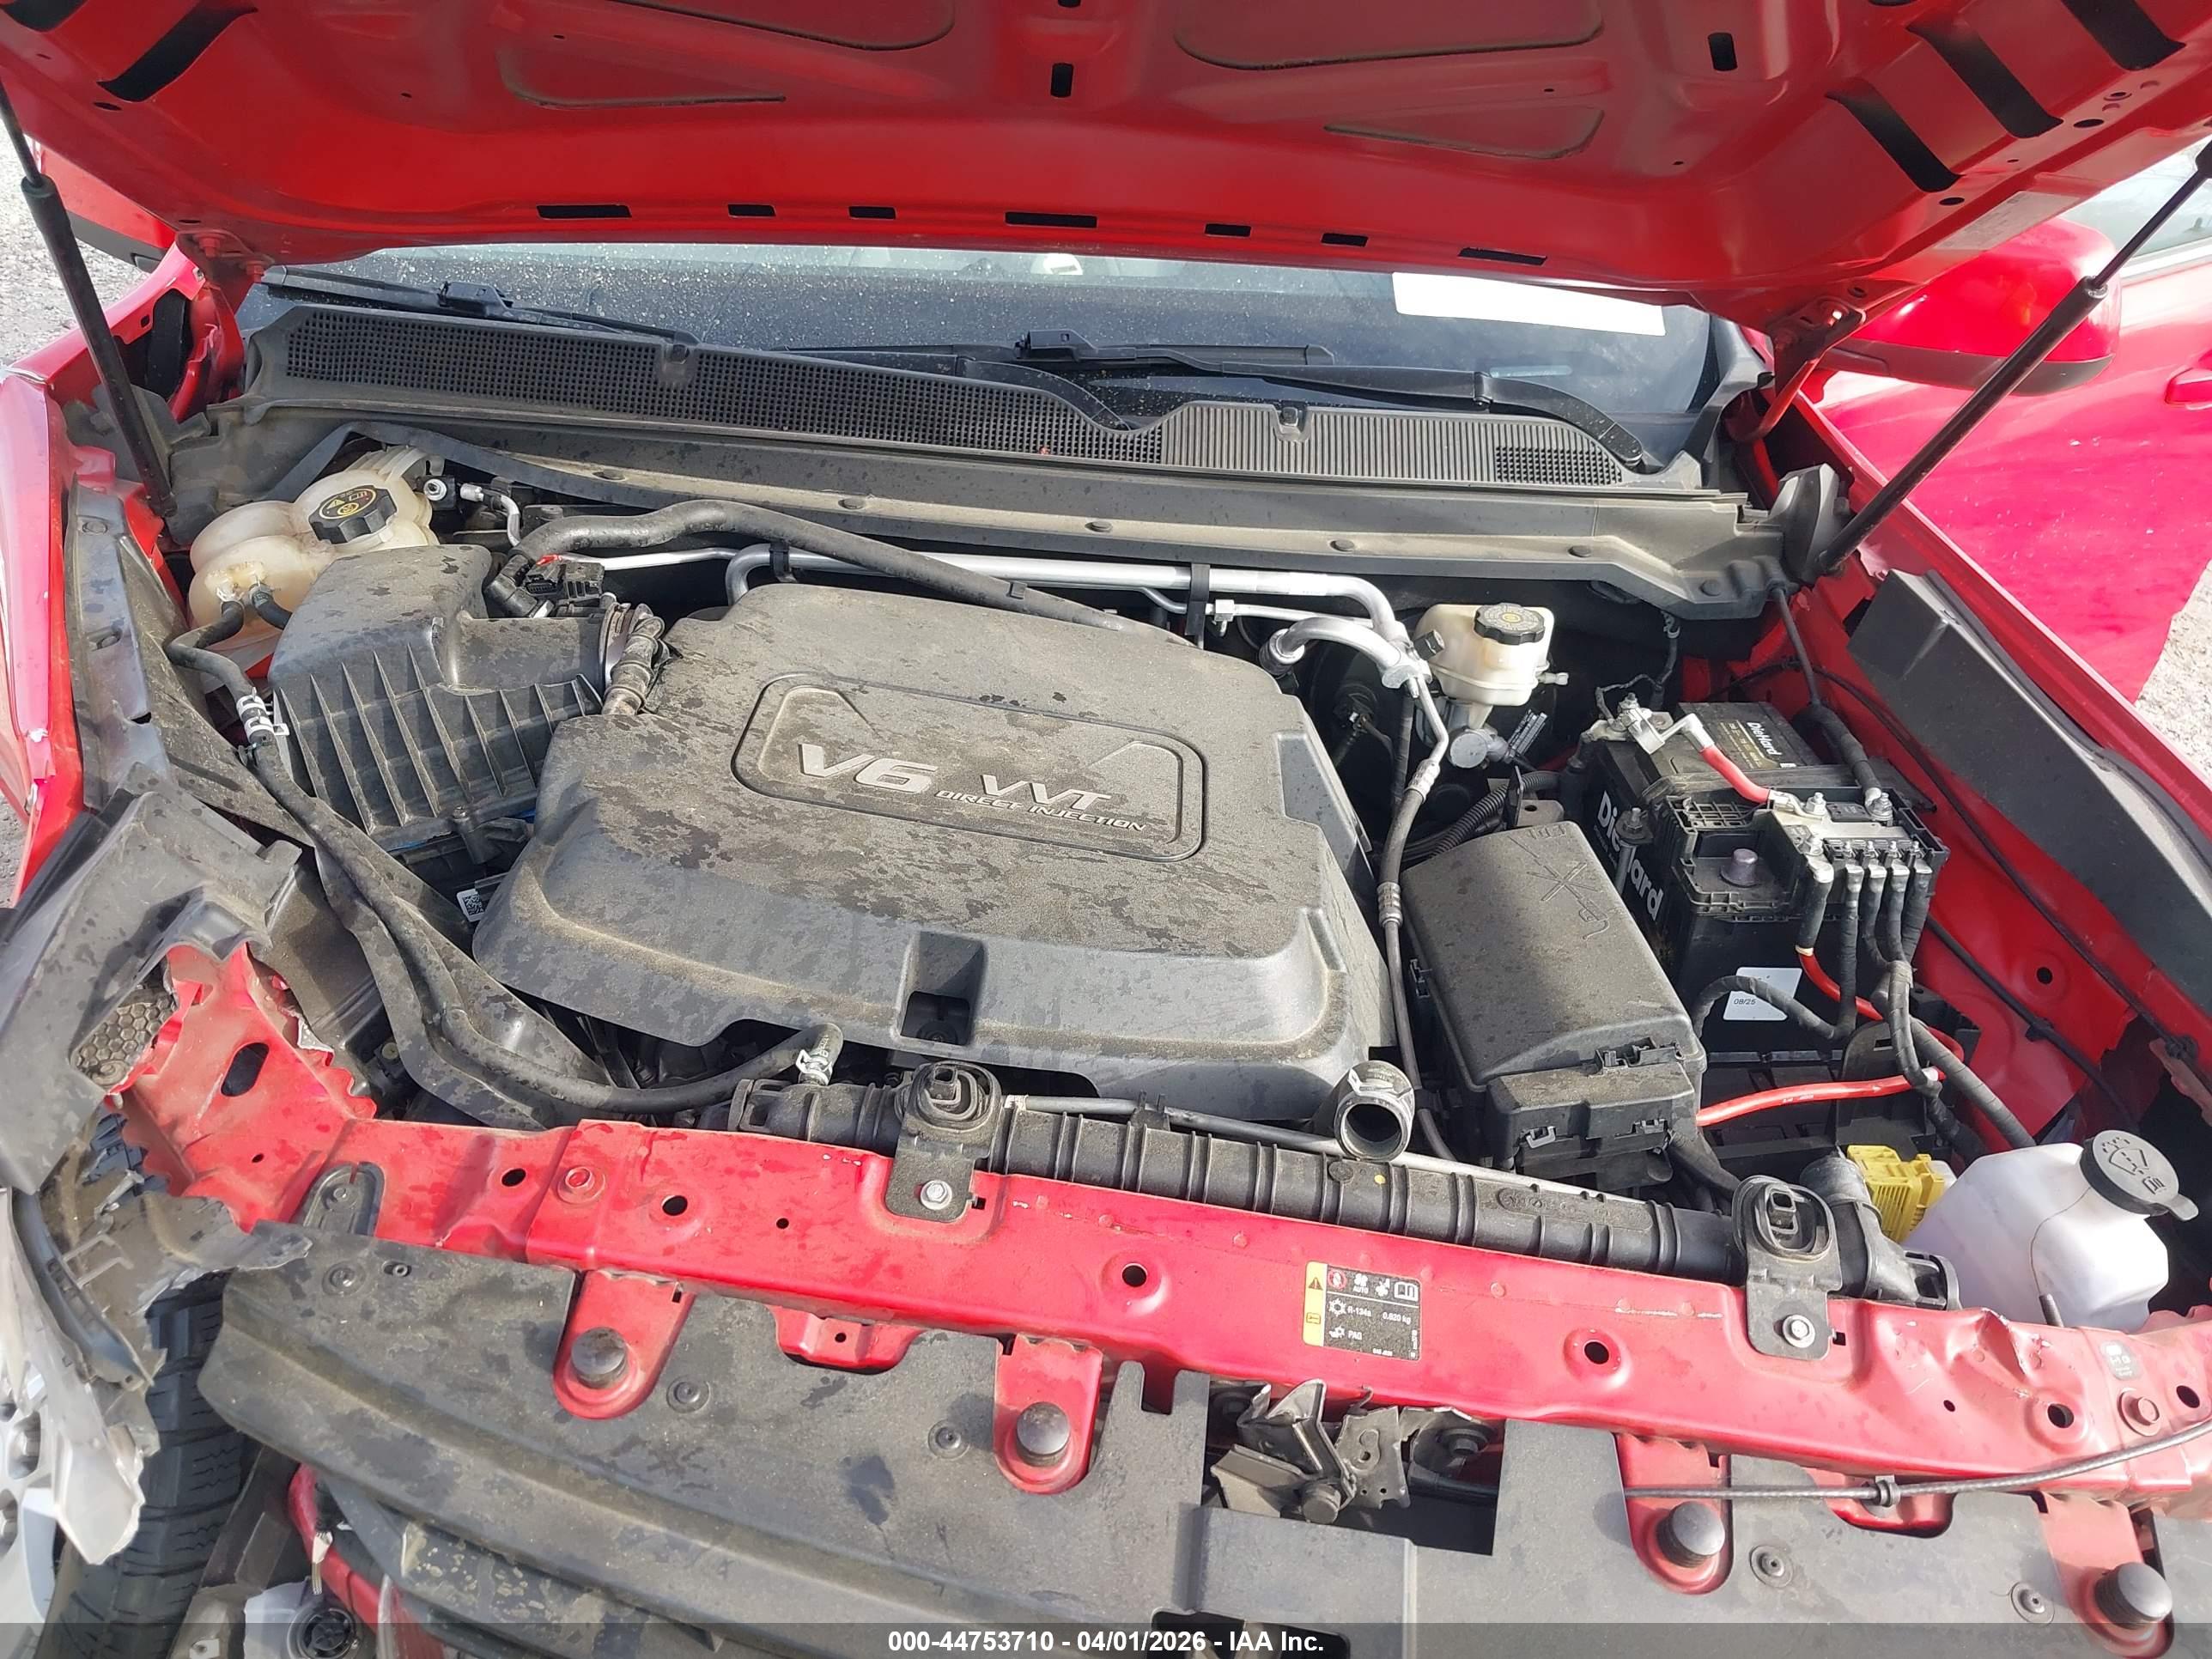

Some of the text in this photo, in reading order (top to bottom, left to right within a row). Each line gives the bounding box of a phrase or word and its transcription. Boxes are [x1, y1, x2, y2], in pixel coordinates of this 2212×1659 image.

[1747, 722, 1783, 756] DieHard
[798, 743, 939, 793] V6
[980, 774, 1112, 810] VVT
[934, 790, 1146, 831] DIRECT INJECTION
[1401, 1316, 1411, 1325] kg
